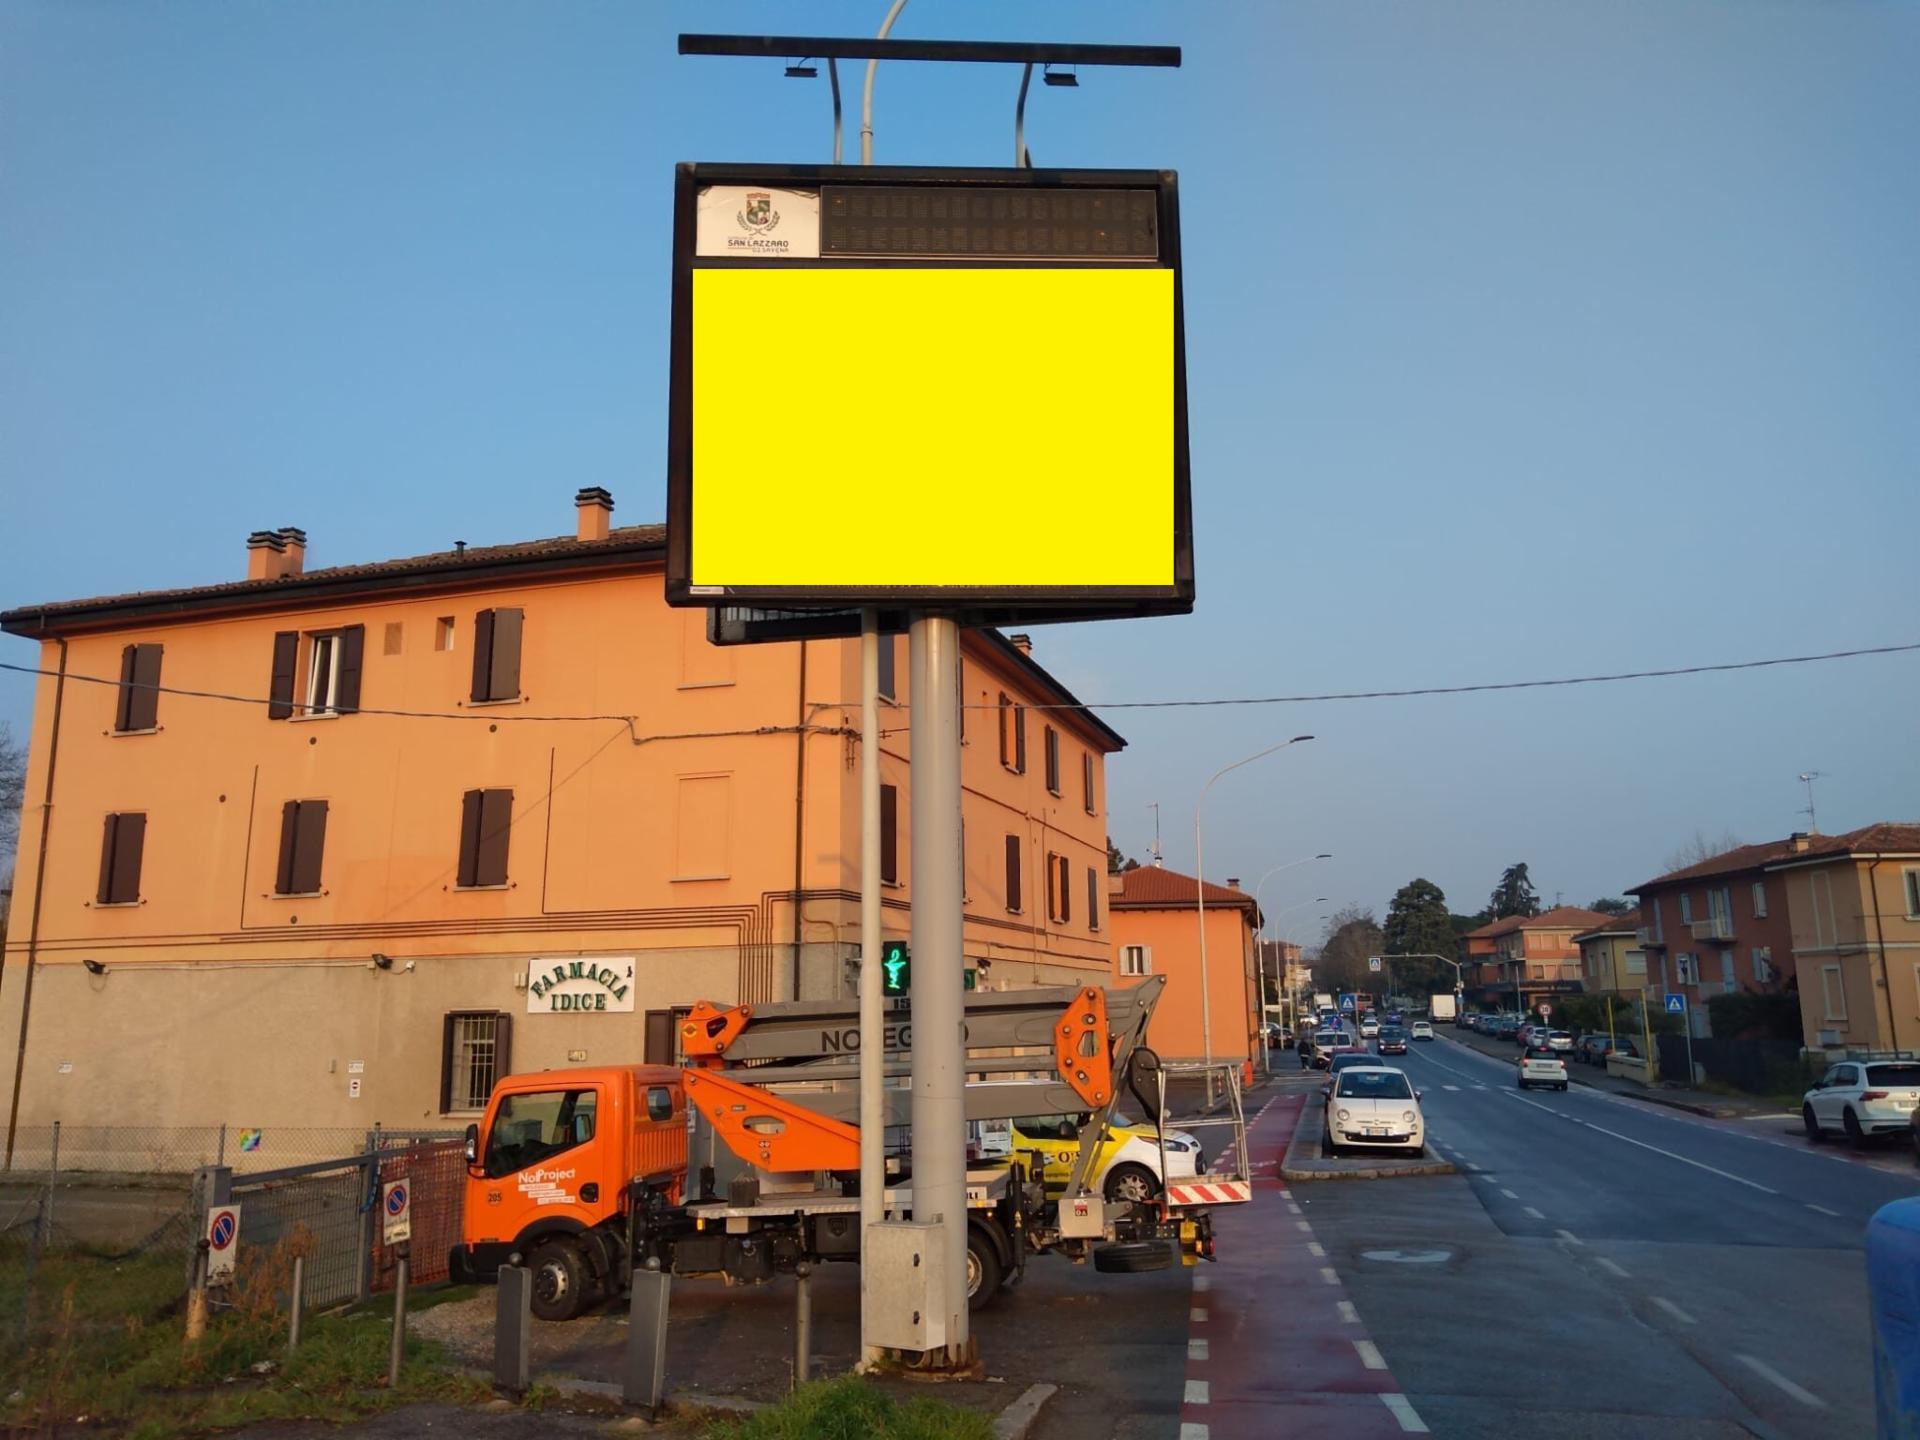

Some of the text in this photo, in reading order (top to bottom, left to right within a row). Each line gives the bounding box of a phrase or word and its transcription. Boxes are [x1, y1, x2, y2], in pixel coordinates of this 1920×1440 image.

[530, 962, 629, 1001] FARMACIA
[551, 994, 606, 1011] IDICE
[518, 1168, 576, 1183] NolProject
